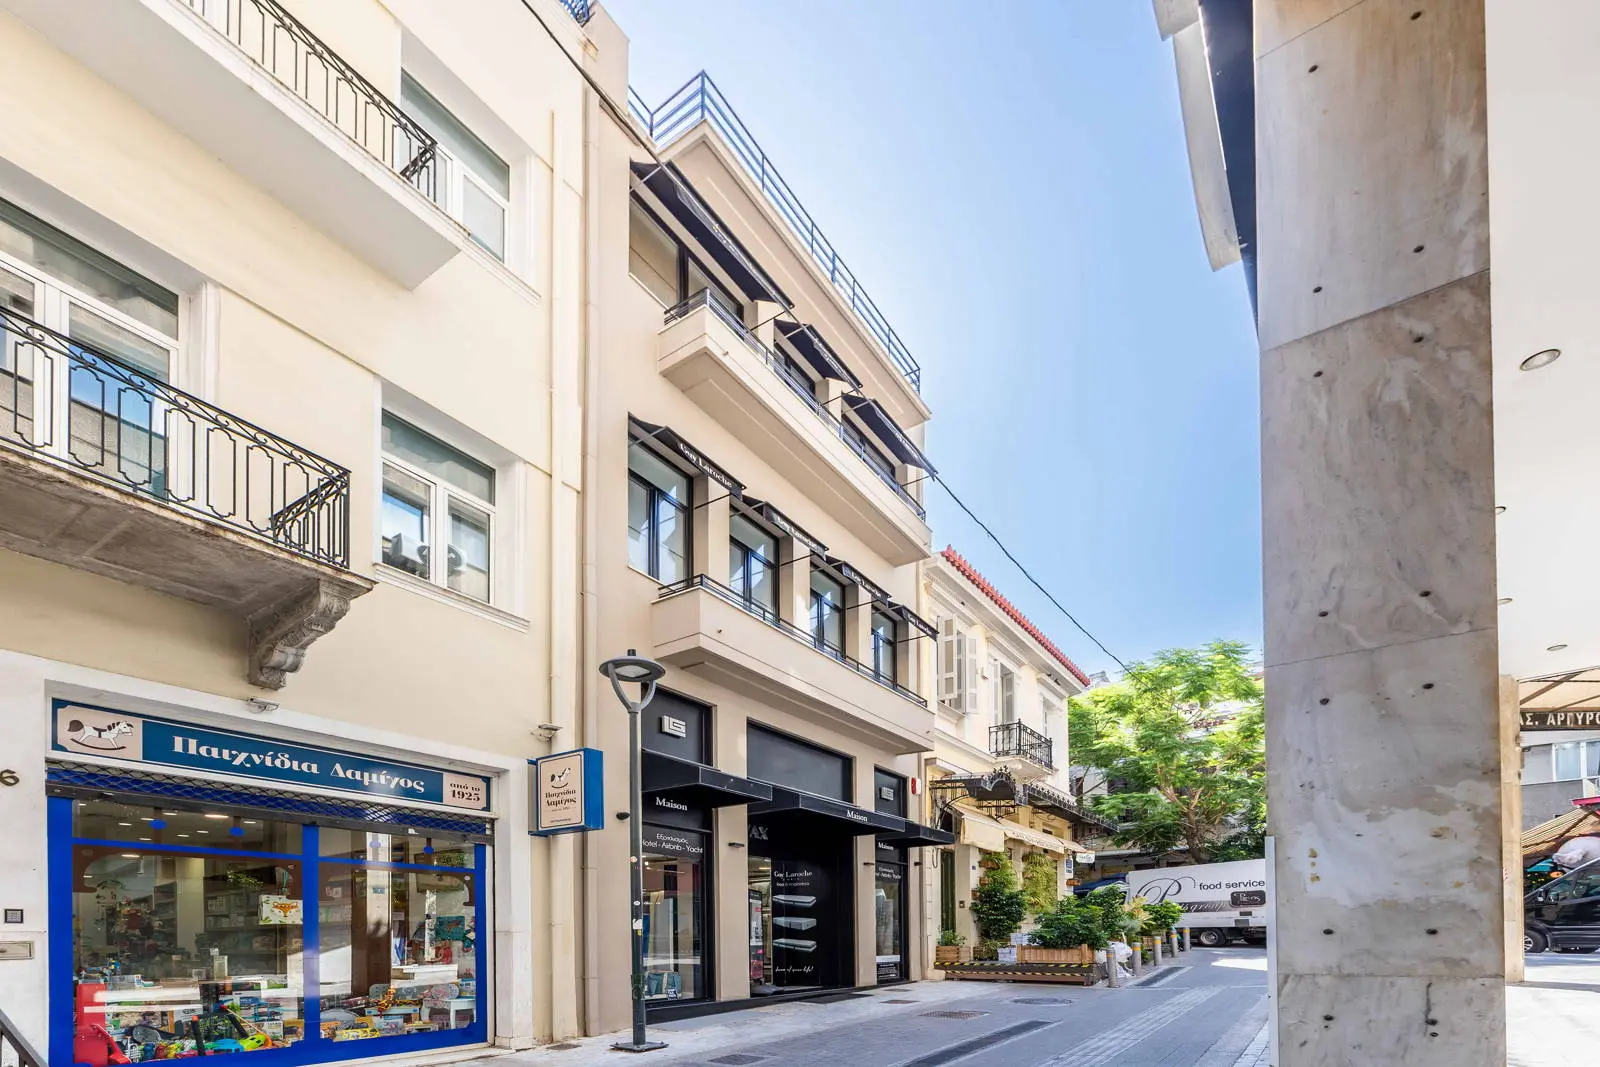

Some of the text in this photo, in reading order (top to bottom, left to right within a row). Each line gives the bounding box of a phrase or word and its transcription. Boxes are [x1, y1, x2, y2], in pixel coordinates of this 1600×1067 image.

[172, 735, 425, 794] Παιχνίδια Δαμίγος
[449, 789, 481, 802] 1925
[655, 796, 688, 811] Maison
[846, 809, 868, 822] Maison
[1199, 879, 1266, 891] food service
